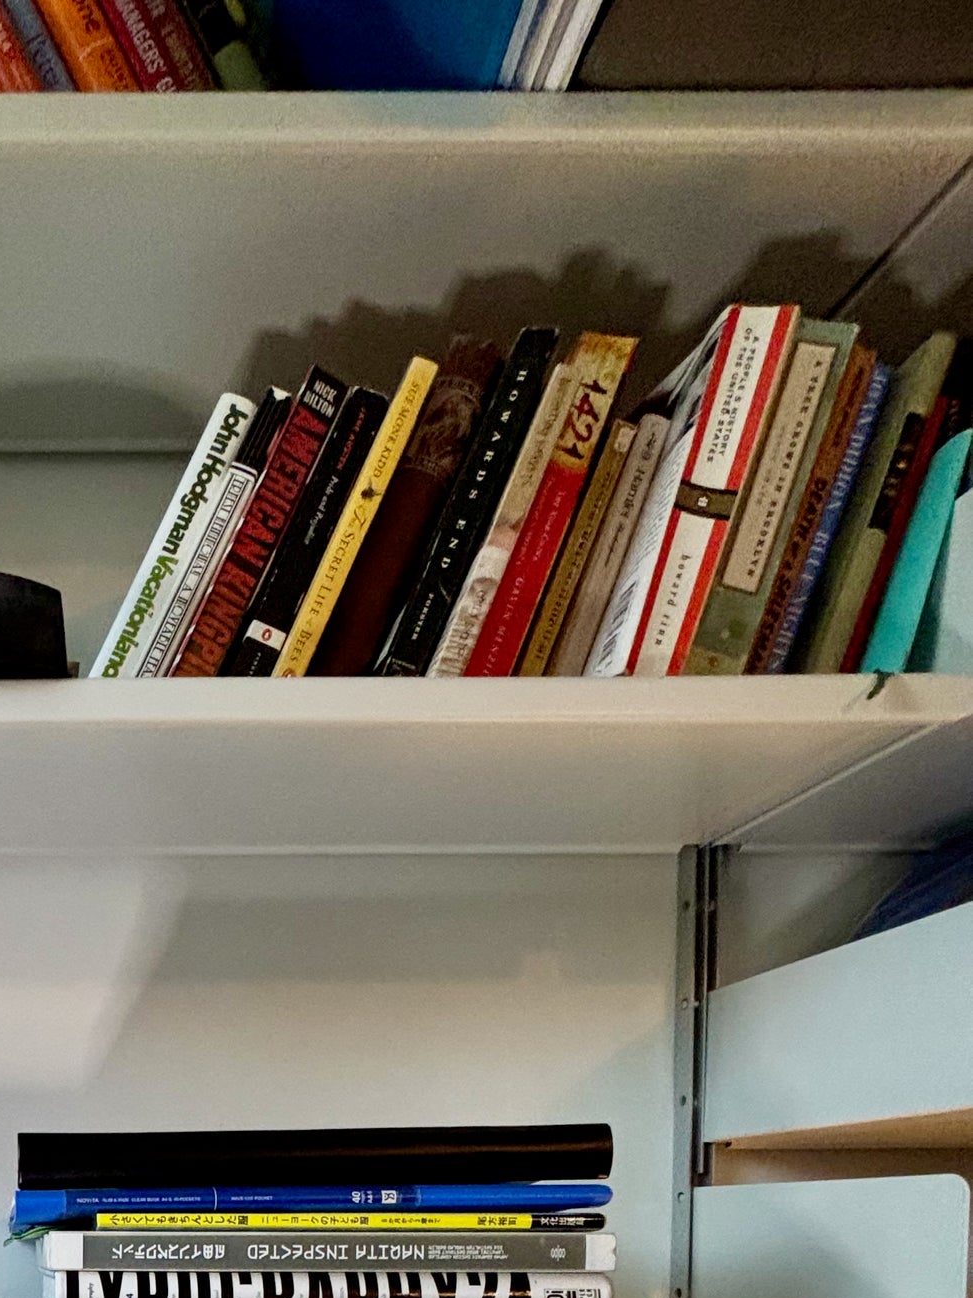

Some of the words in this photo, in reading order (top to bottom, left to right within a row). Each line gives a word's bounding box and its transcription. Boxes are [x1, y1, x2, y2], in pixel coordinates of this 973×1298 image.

[743, 326, 753, 343] OF
[734, 345, 747, 369] THE
[304, 390, 336, 418] BILTON
[314, 379, 337, 403] NICK
[721, 372, 738, 416] UNITED
[207, 403, 248, 454] John
[468, 369, 529, 500] HOWARDS
[557, 379, 609, 462] 1421
[706, 419, 723, 463] STATES
[717, 404, 738, 458] HISTORY
[372, 445, 392, 479] KIDD
[163, 452, 226, 555] Hodgman
[229, 404, 328, 568] AMERICAN
[325, 530, 356, 583] SECRET
[440, 517, 468, 570] END
[308, 583, 333, 618] LIFE
[503, 575, 526, 621] GAVIN
[290, 629, 314, 664] BEES
[351, 1191, 362, 1204] 40
[247, 1244, 348, 1259] INSPECTED
[356, 1244, 424, 1259] NARITA
